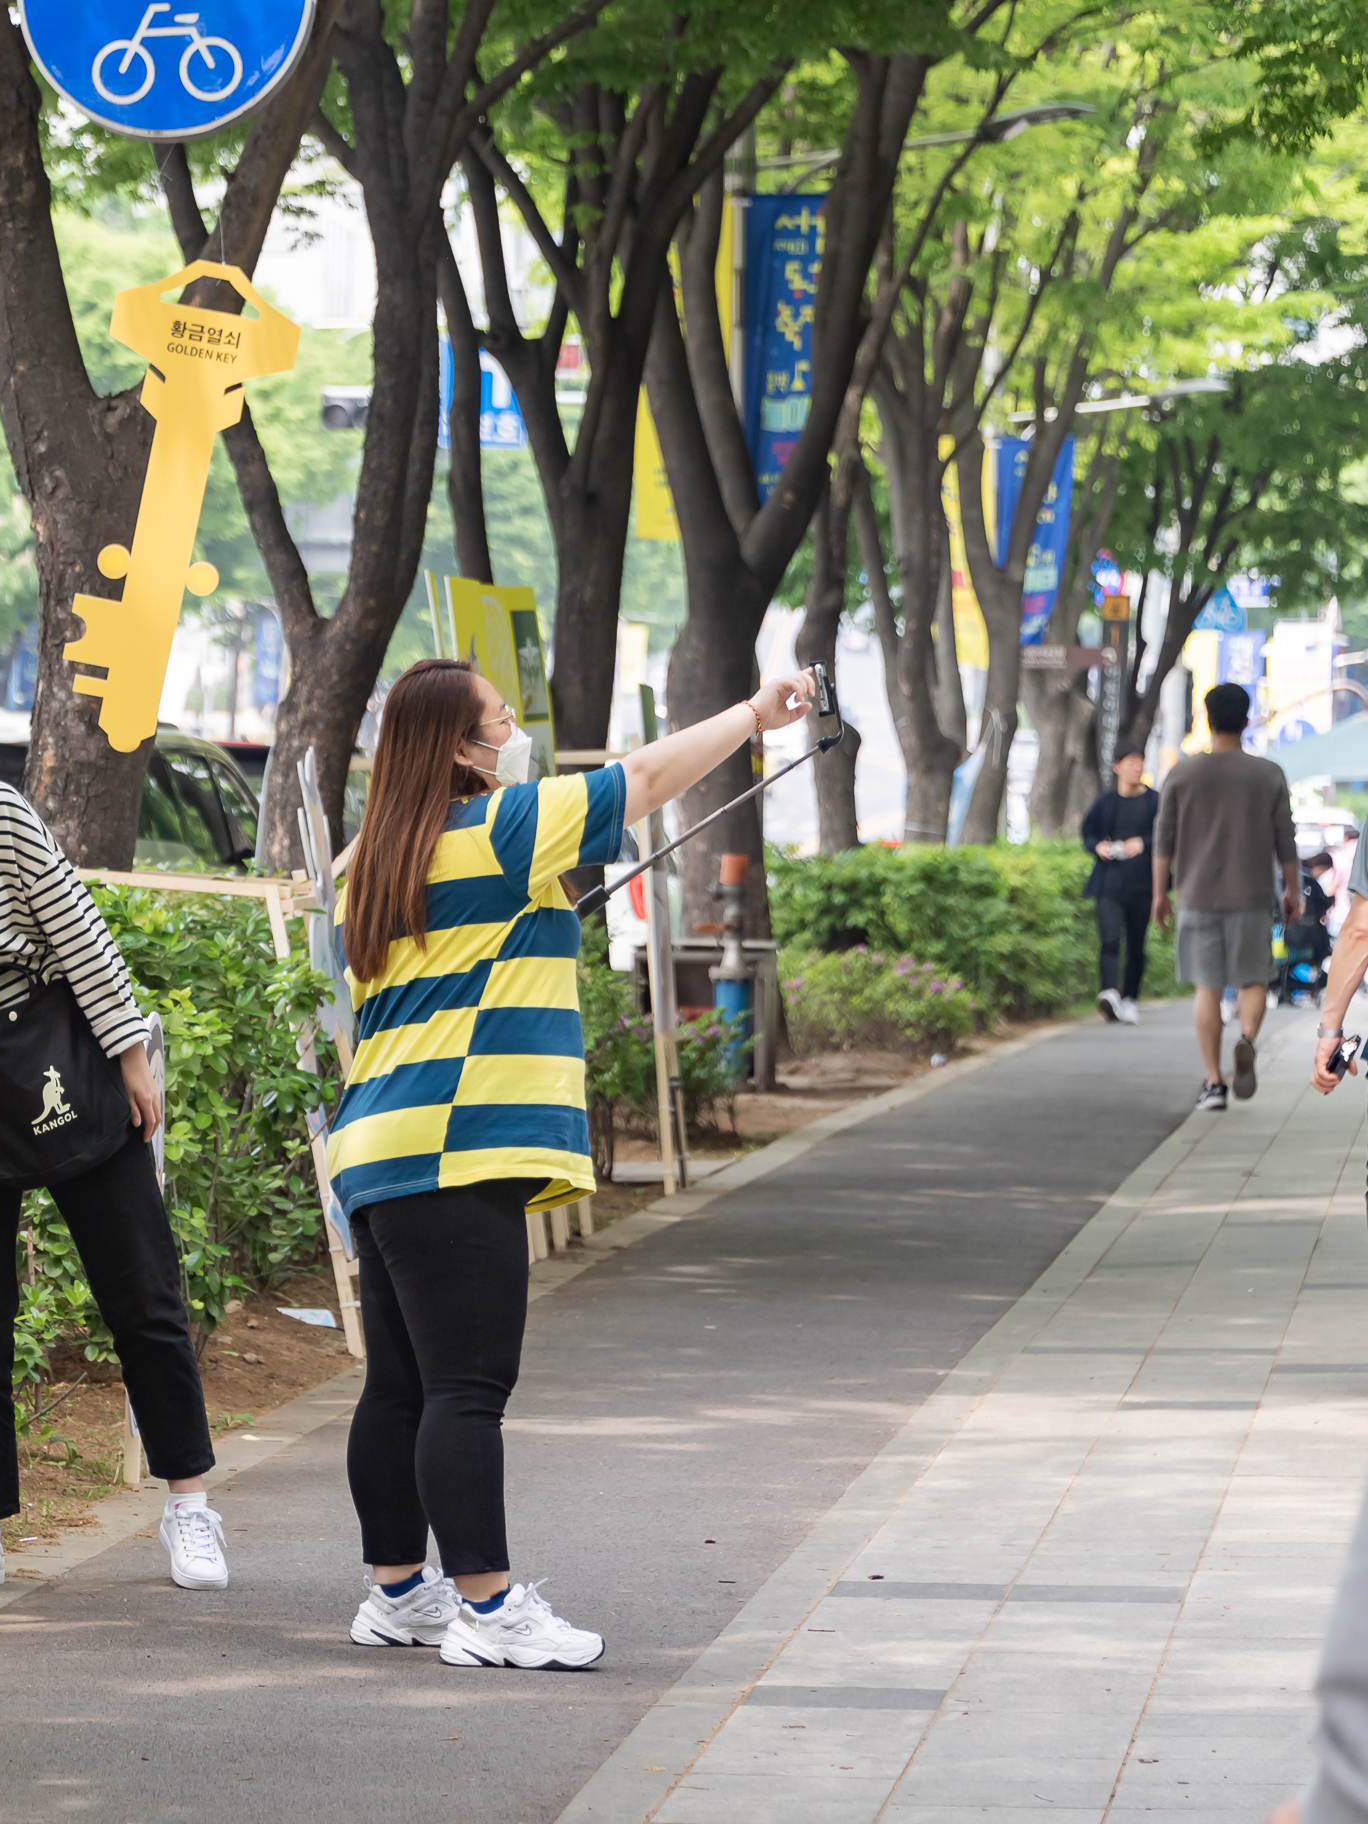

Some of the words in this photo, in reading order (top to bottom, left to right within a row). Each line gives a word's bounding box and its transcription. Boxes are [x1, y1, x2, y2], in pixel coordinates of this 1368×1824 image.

[170, 320, 241, 349] 황금열쇠
[167, 342, 213, 360] GOLDEN
[215, 351, 238, 365] KEY
[33, 1110, 78, 1136] KANGOL
